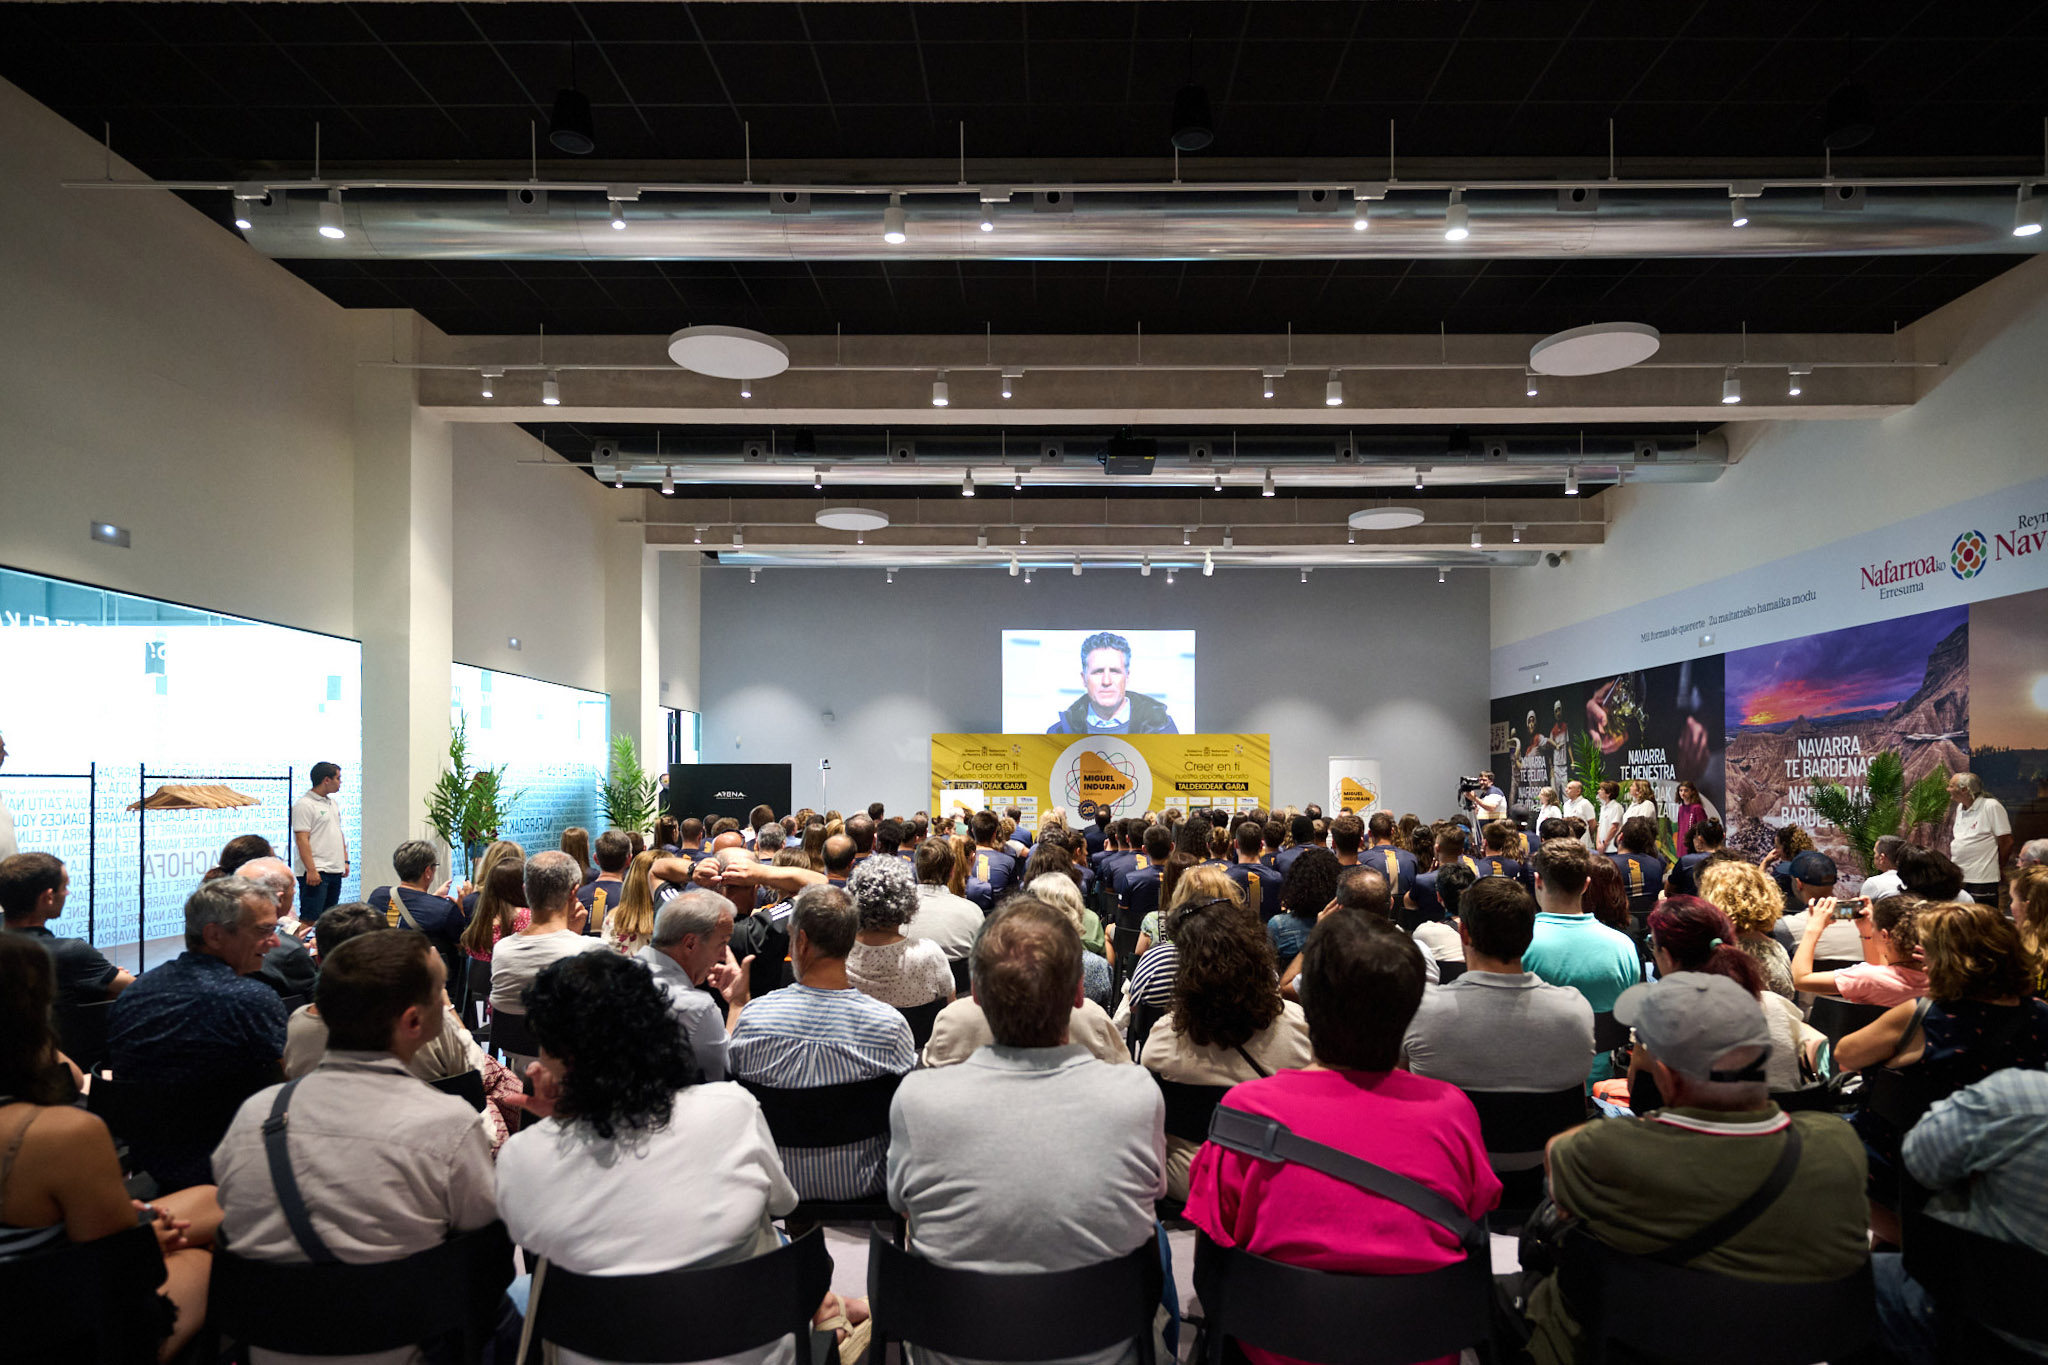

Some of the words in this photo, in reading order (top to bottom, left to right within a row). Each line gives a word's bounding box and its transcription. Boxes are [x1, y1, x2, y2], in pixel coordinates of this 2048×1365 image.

[1880, 581, 1924, 600] Erresuma
[1640, 633, 1650, 643] Mil
[1650, 628, 1671, 641] formas
[1671, 626, 1678, 637] de
[1678, 619, 1705, 637] quererte
[1708, 615, 1718, 627] Zu
[1718, 606, 1757, 625] maitatzeko
[1757, 595, 1791, 615] hamaika
[1791, 589, 1817, 606] modu
[1798, 735, 1861, 758] NAVARRA
[1628, 748, 1666, 765] NAVARRA
[963, 761, 993, 771] Creer
[1013, 762, 1019, 771] ti
[1184, 761, 1214, 771] Creer
[1217, 763, 1231, 771] en
[1234, 762, 1240, 771] ti
[1620, 766, 1631, 780] TE
[1631, 764, 1676, 780] MENESTRA
[1784, 759, 1800, 778] TE
[978, 772, 1004, 780] deporte
[1200, 773, 1225, 781] deporte
[1520, 769, 1527, 782] TE
[1527, 769, 1549, 782] PELOTA
[1003, 782, 1024, 790] GARA
[1178, 782, 1224, 790] TALDEKIDEAK
[1225, 782, 1246, 790] GARA
[1518, 786, 1542, 799] NAFARRO
[1788, 785, 1873, 807] NAFOAK
[1657, 802, 1679, 822] ZAIT
